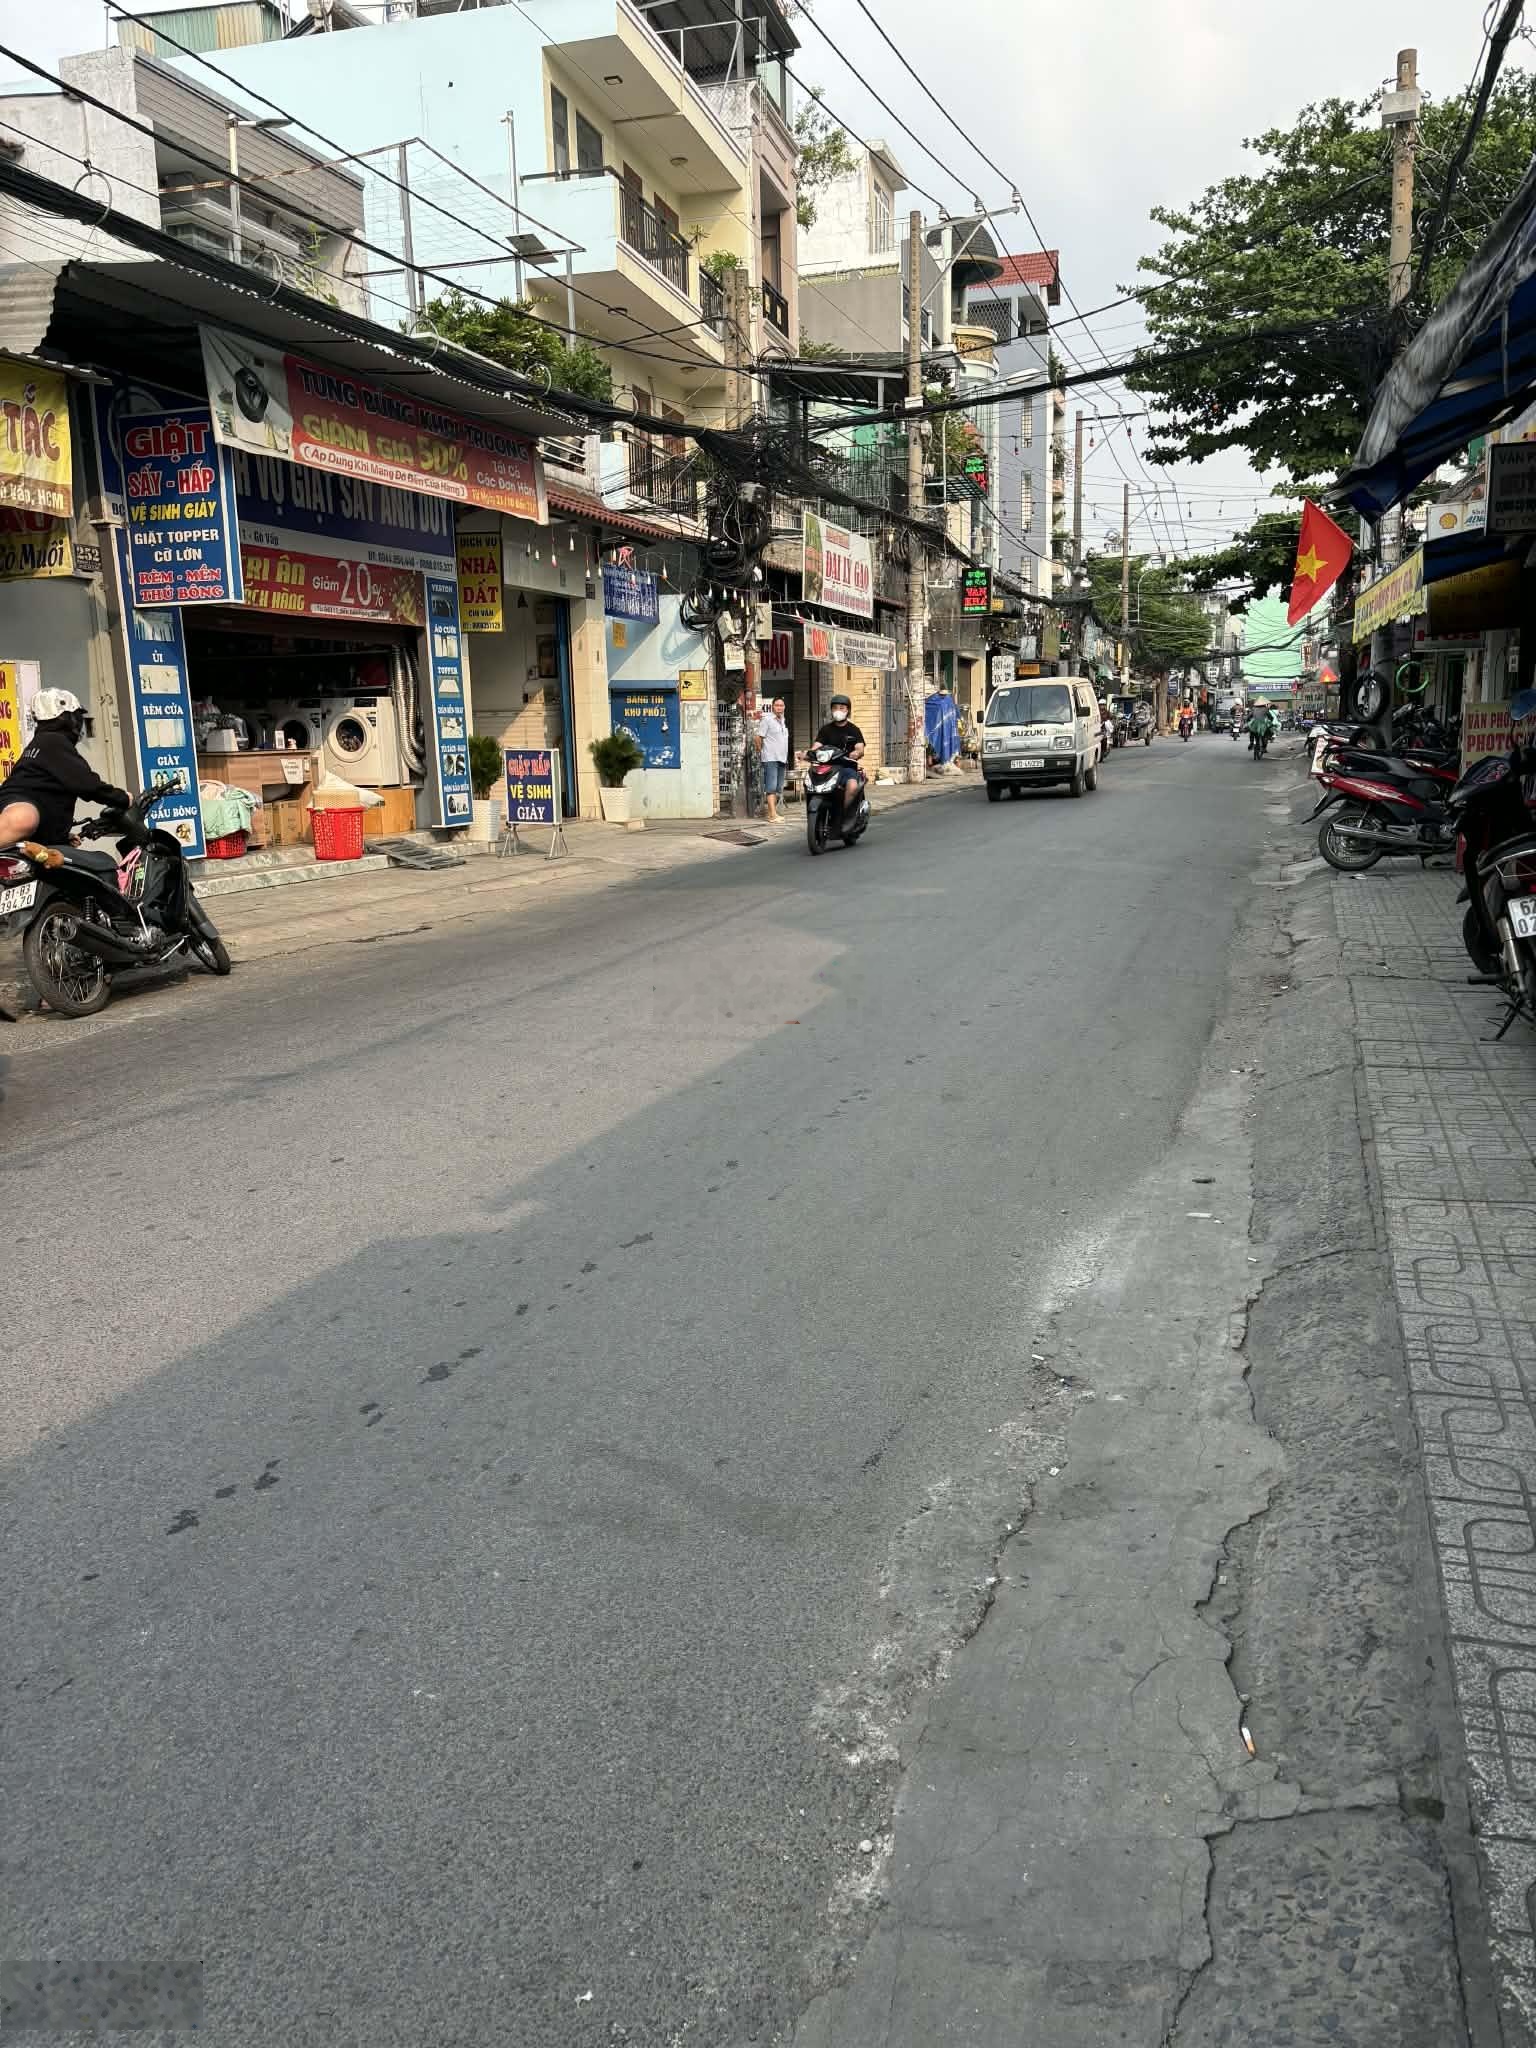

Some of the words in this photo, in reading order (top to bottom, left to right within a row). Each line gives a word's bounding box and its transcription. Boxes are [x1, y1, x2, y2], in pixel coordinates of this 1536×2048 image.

[1, 383, 62, 462] TẮC
[126, 418, 210, 463] GIẶT
[128, 463, 162, 497] SẤY
[177, 460, 215, 495] HẤP
[152, 503, 180, 521] SINH
[184, 498, 217, 518] GIÀY
[167, 528, 219, 543] TOPPER
[77, 546, 100, 562] 252
[461, 552, 498, 575] NHÀ
[139, 569, 174, 586] RÈM
[140, 585, 174, 602] THÚ
[177, 584, 224, 600] BÔNG
[624, 708, 641, 717] KHU
[1010, 728, 1047, 738] SUZUKI
[157, 755, 180, 767] GIÀY
[510, 781, 524, 803] VỆ
[527, 784, 552, 800] SINH
[173, 806, 197, 817] BÔNG
[517, 803, 545, 820] GIÀY
